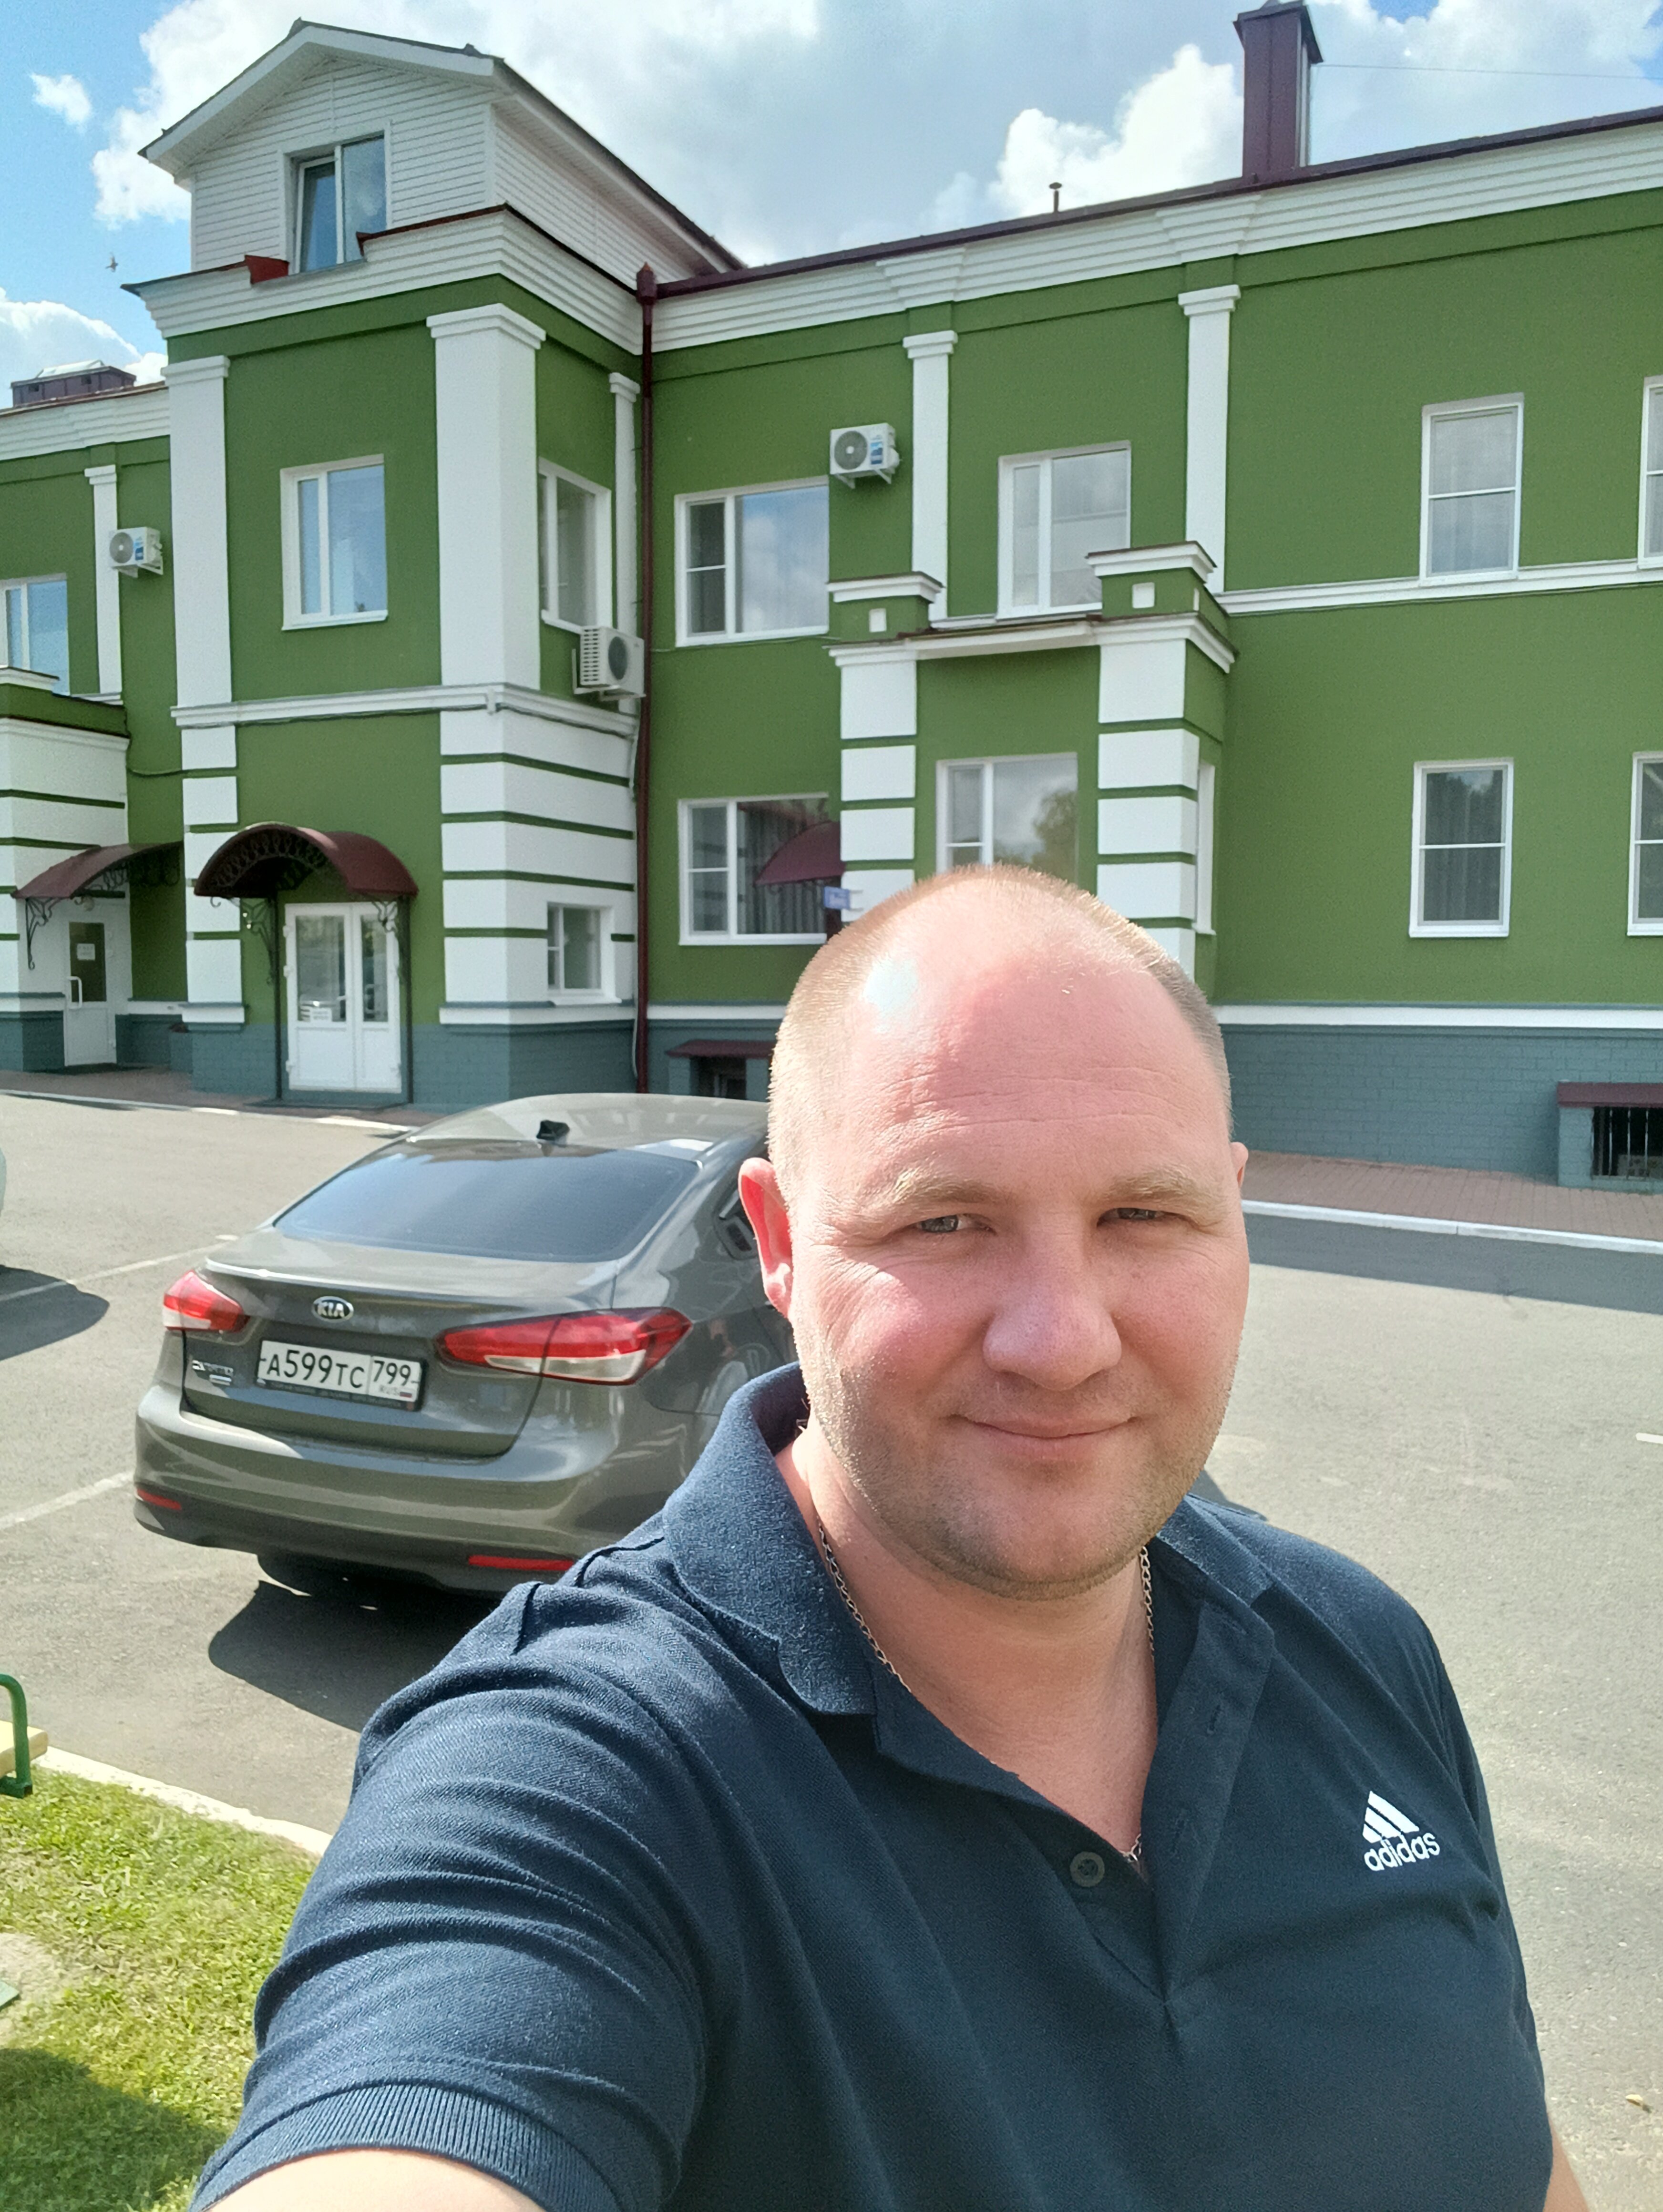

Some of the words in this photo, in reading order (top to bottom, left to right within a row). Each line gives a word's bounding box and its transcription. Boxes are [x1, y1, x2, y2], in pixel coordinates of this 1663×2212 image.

[317, 1301, 345, 1317] KIA
[374, 1360, 411, 1386] 799
[1364, 1833, 1440, 1871] adidas
